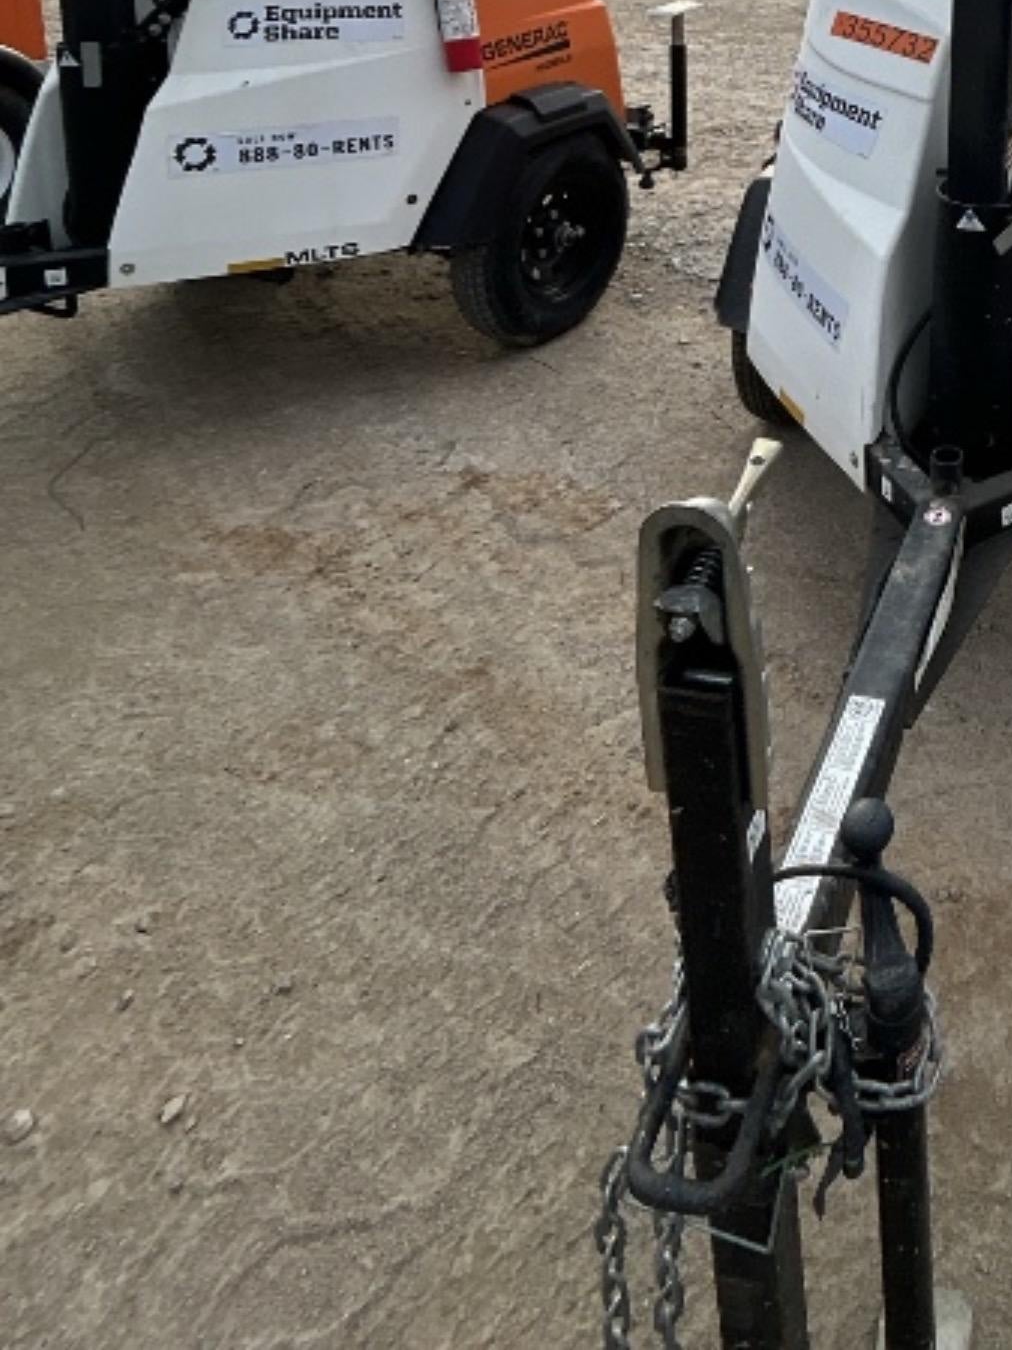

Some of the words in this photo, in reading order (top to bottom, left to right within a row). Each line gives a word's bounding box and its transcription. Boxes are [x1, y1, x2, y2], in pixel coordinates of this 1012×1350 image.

[264, 2, 403, 25] Equipment
[263, 24, 340, 42] Share
[482, 20, 569, 61] GENERAC
[842, 14, 938, 63] 355732
[239, 134, 395, 163] 888-80-RENTS
